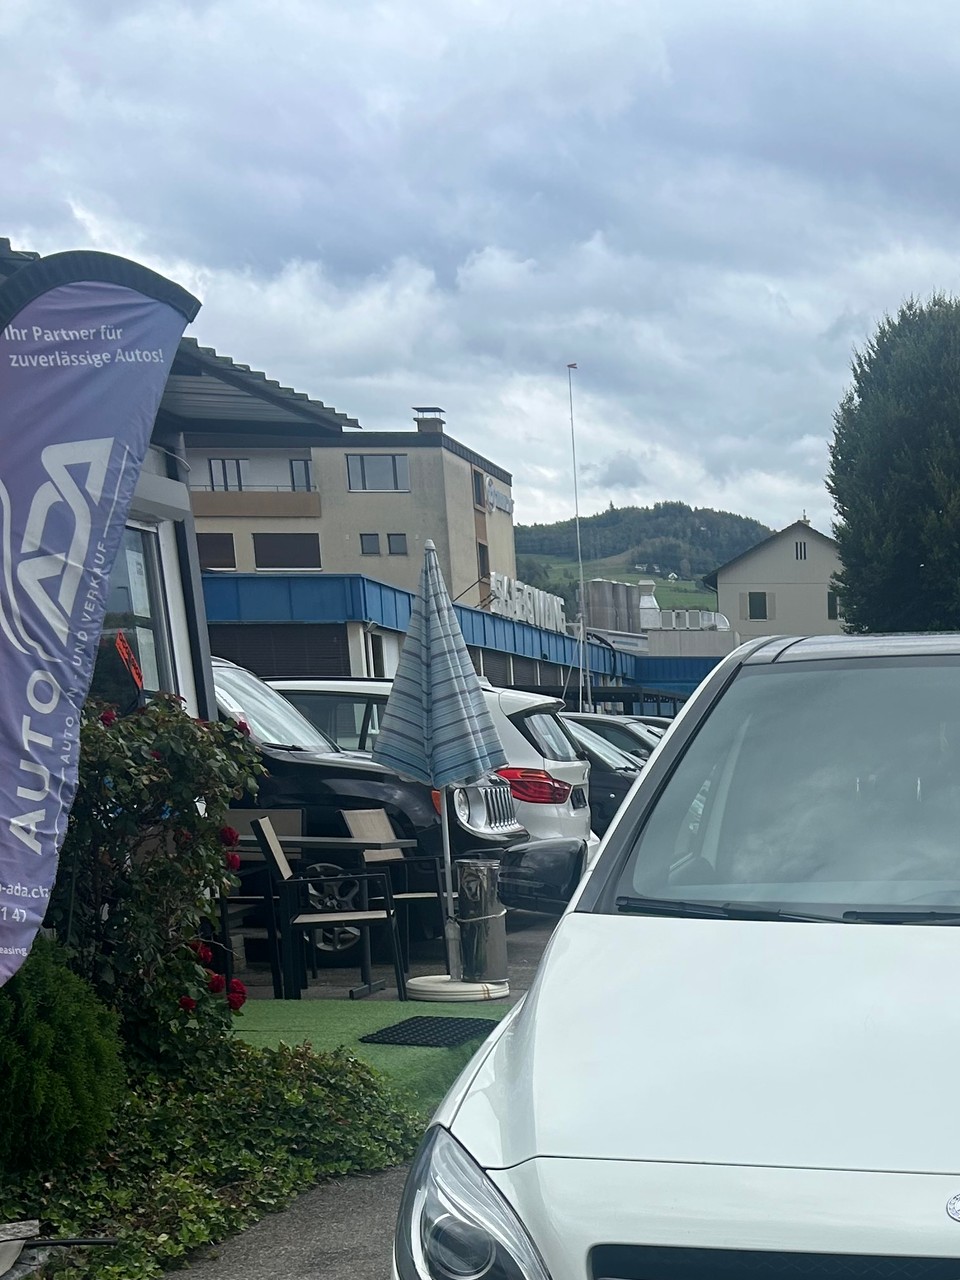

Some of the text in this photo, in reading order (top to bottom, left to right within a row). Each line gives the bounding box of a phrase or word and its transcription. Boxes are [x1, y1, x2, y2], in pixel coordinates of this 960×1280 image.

[4, 324, 123, 342] Ihr Partner für
[9, 348, 164, 369] zuverlässige Autos!
[9, 437, 115, 856] AUTO ADA
[60, 716, 75, 764] AUTO
[72, 630, 88, 667] UND
[82, 541, 107, 622] VERKAUF
